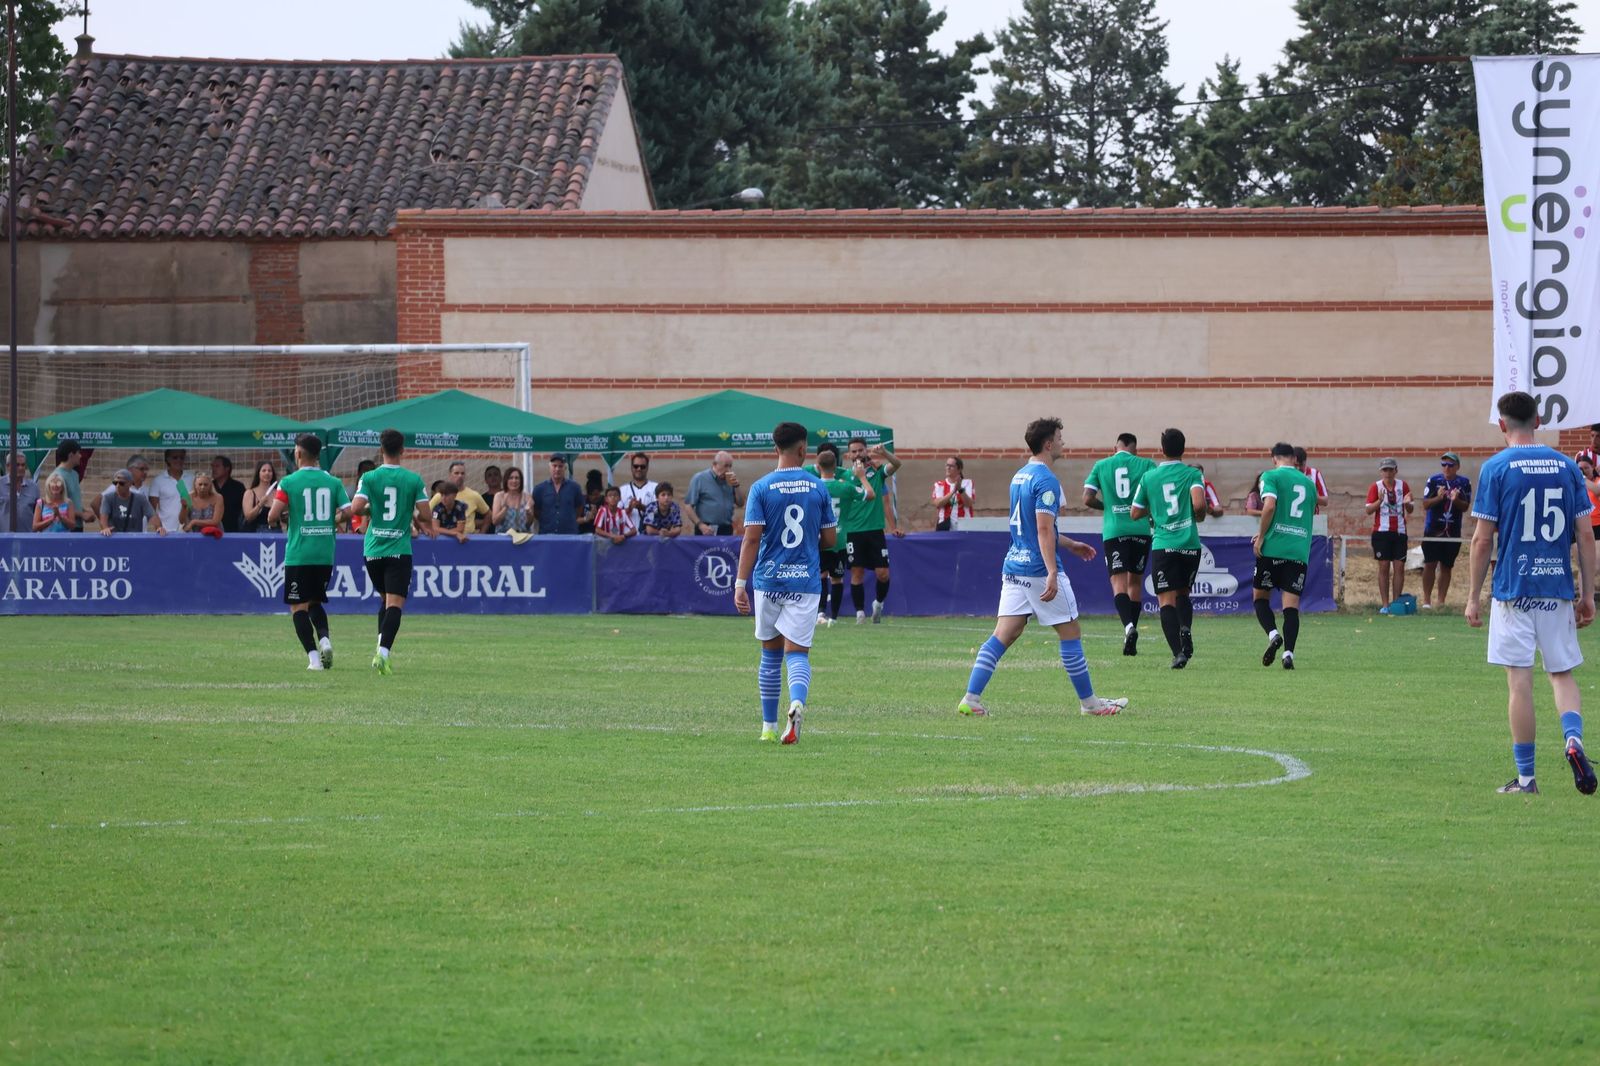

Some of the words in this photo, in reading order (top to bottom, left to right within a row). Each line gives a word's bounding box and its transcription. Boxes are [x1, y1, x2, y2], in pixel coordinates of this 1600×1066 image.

[1512, 61, 1582, 425] synergias
[57, 432, 80, 440] CAJA
[82, 432, 113, 440] RURAL
[163, 433, 185, 441] CAJA
[187, 433, 218, 441] RURAL
[263, 433, 285, 441] CAJA
[631, 435, 653, 443] CAJA
[655, 435, 685, 443] RURAL
[732, 433, 753, 441] CAJA
[828, 430, 849, 438] CAJA
[851, 429, 881, 438] RURAL
[1115, 467, 1130, 498] 6
[302, 487, 331, 521] 10
[383, 487, 397, 521] 3
[1162, 483, 1179, 516] 5
[1290, 484, 1306, 518] 2
[1010, 497, 1022, 536] 4
[1520, 487, 1566, 542] 15
[781, 504, 804, 549] 8
[0, 557, 97, 573] AMIENTO
[102, 557, 131, 573] DE
[1531, 567, 1565, 576] ZAMORA
[413, 565, 546, 598] RURAL
[776, 571, 810, 579] ZAMORA
[2, 578, 133, 601] ARALBO
[1215, 601, 1239, 613] 1929
[1513, 597, 1558, 612] Alfonso
